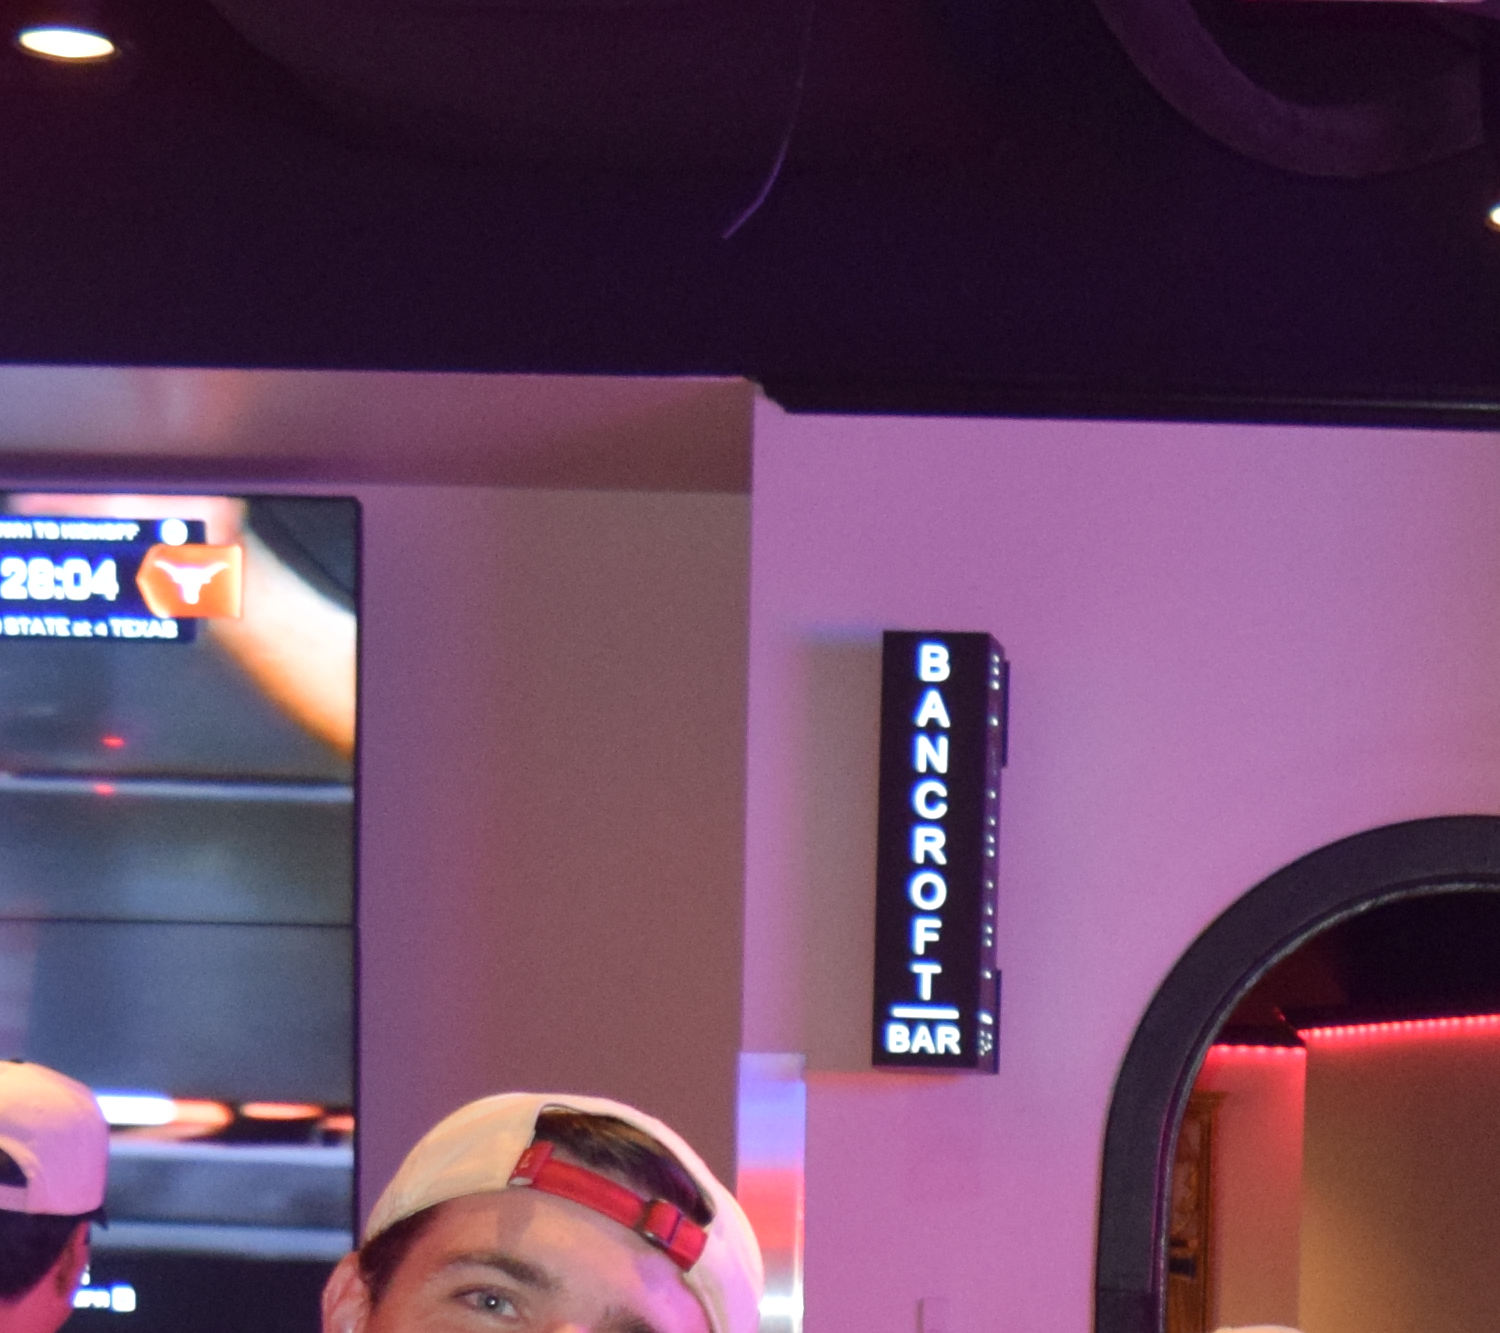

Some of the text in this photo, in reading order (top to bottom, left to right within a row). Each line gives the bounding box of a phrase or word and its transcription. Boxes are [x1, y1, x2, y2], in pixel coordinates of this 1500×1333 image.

[34, 519, 59, 539] TO
[0, 557, 119, 601] 28:04
[4, 618, 70, 637] STATE
[109, 619, 178, 639] TEXAS
[909, 644, 951, 1000] BANCROFT
[887, 1025, 961, 1055] BAR
